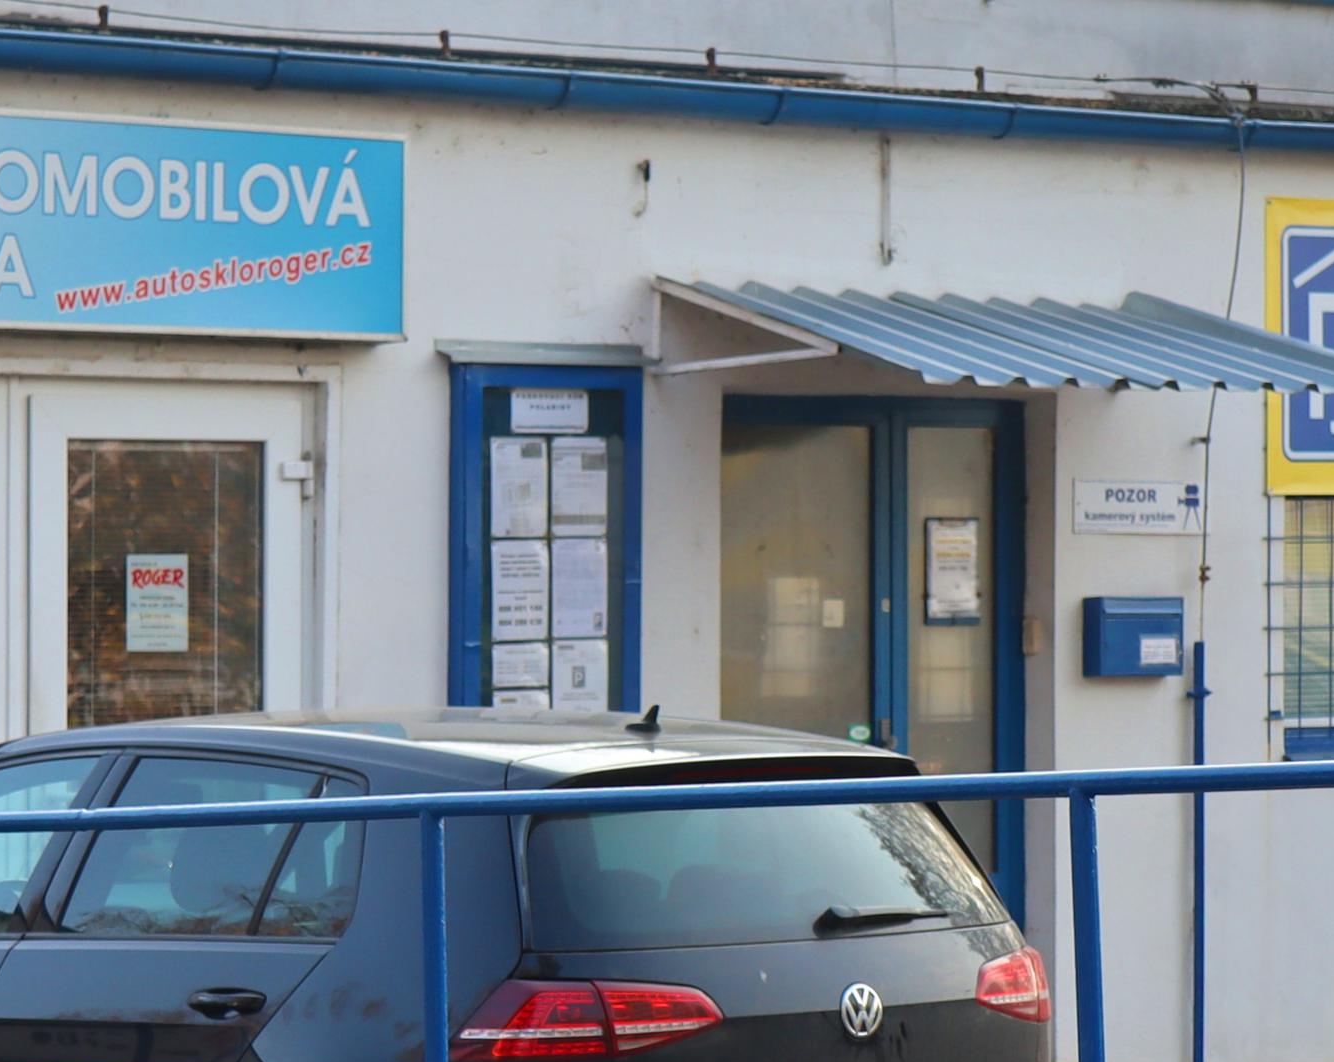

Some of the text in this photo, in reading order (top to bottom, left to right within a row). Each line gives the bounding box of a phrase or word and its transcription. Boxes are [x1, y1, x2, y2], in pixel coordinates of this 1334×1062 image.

[56, 242, 372, 312] www.autoskloroger.cz
[1104, 488, 1158, 503] POZOR
[1084, 511, 1176, 524] kamerový systém
[131, 568, 185, 590] ROGER
